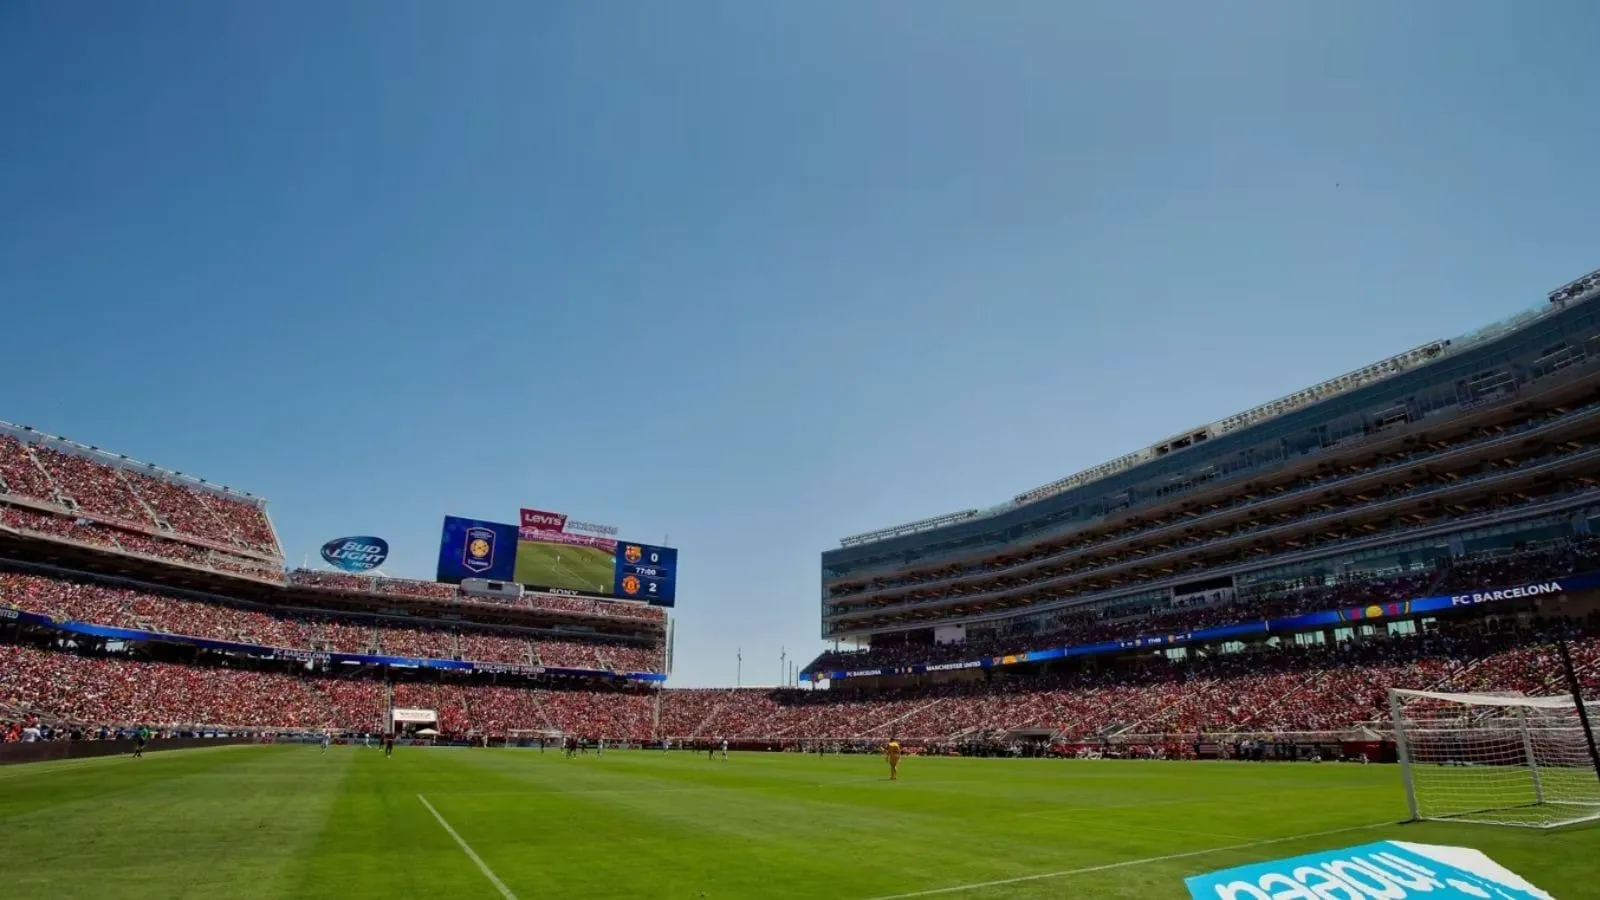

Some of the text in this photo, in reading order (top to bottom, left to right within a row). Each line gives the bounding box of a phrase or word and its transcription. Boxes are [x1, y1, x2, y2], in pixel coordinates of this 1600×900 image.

[342, 541, 381, 554] BUD
[330, 549, 385, 563] LIGHT
[651, 553, 659, 563] 0
[550, 588, 579, 596] SONY
[649, 583, 657, 592] 2
[1452, 582, 1562, 606] FC BARCELONA
[284, 649, 331, 660] BARCELONA
[521, 666, 546, 674] UNITED
[926, 663, 962, 671] MANCHESTER
